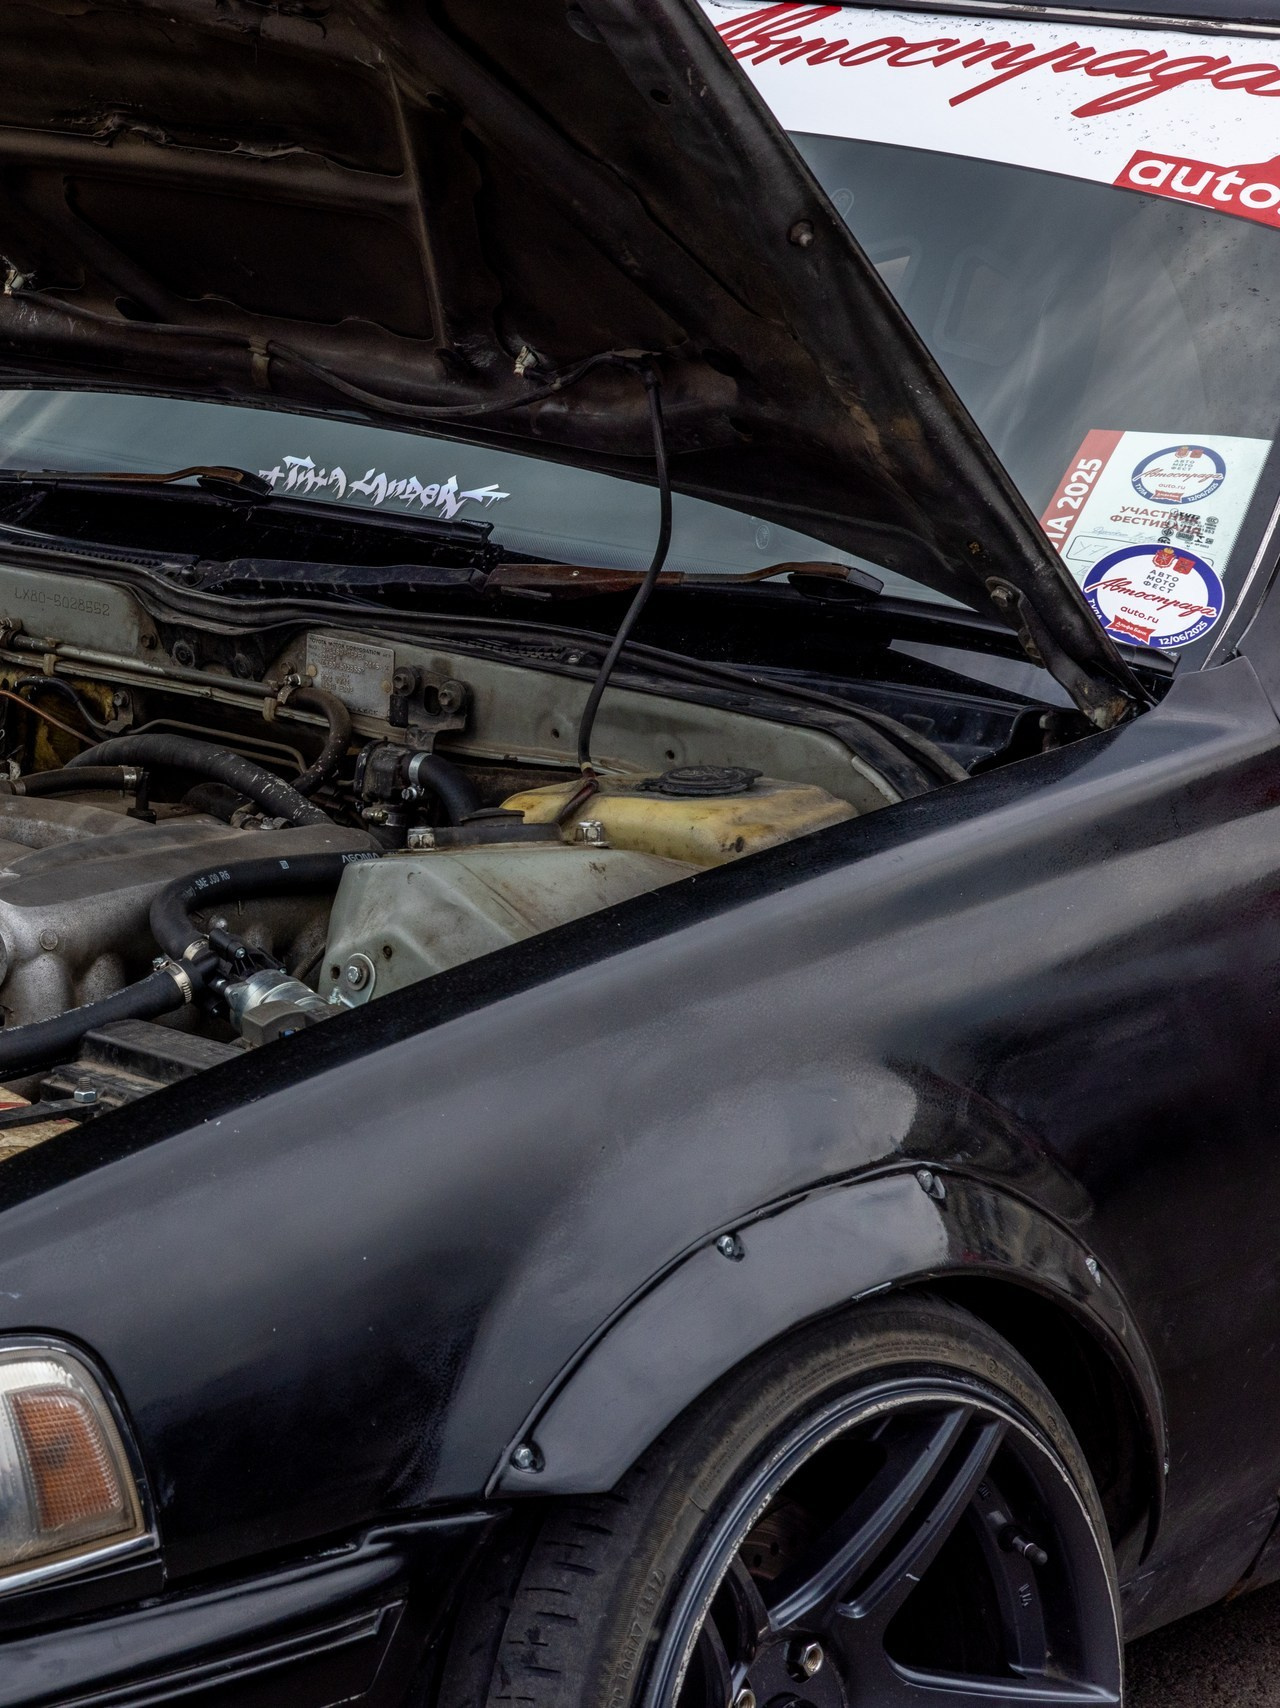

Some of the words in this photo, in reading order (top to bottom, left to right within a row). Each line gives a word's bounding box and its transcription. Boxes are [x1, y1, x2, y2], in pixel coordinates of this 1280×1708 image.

[1057, 459, 1102, 510] 2025
[1158, 482, 1186, 490] auto.ru
[1146, 575, 1177, 588] МОТО
[1149, 569, 1179, 582] АВТО
[1143, 581, 1174, 593] ФЕСТ
[1085, 577, 1217, 618] Автострада
[1120, 605, 1160, 624] auto.ru
[1158, 621, 1208, 645] 12/06/2025
[195, 876, 210, 890] SAE
